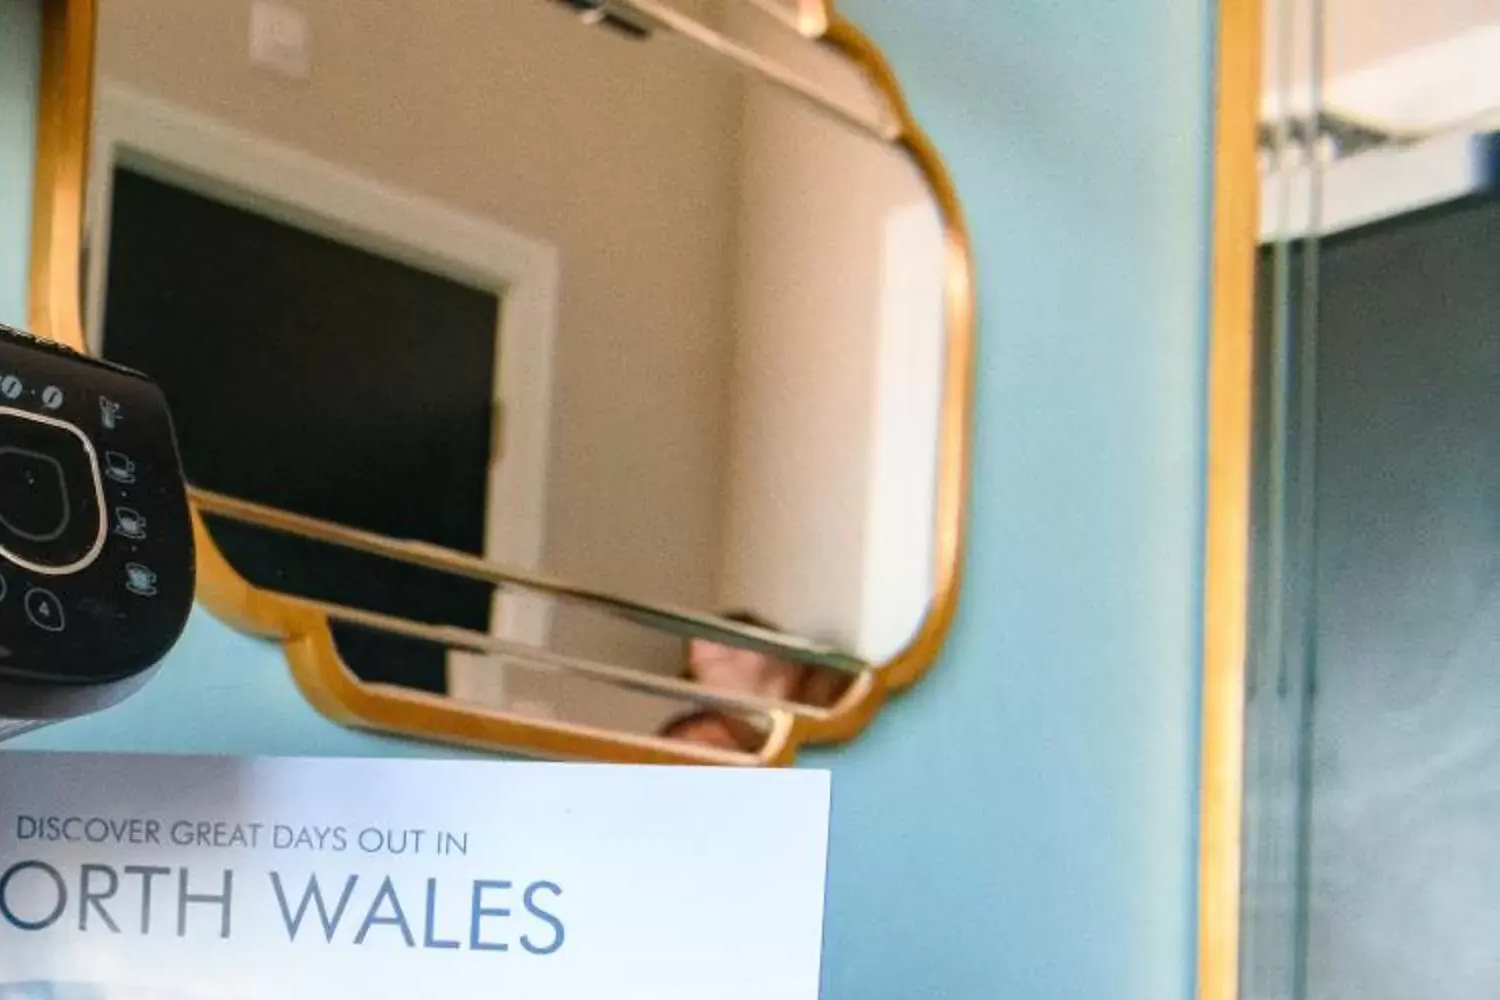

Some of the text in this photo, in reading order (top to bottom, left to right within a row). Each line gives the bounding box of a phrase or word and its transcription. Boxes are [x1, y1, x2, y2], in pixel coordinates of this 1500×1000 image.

[39, 600, 51, 617] 4
[16, 815, 469, 856] DISCOVER GREAT DAYS OUT IN
[268, 869, 566, 956] WALES
